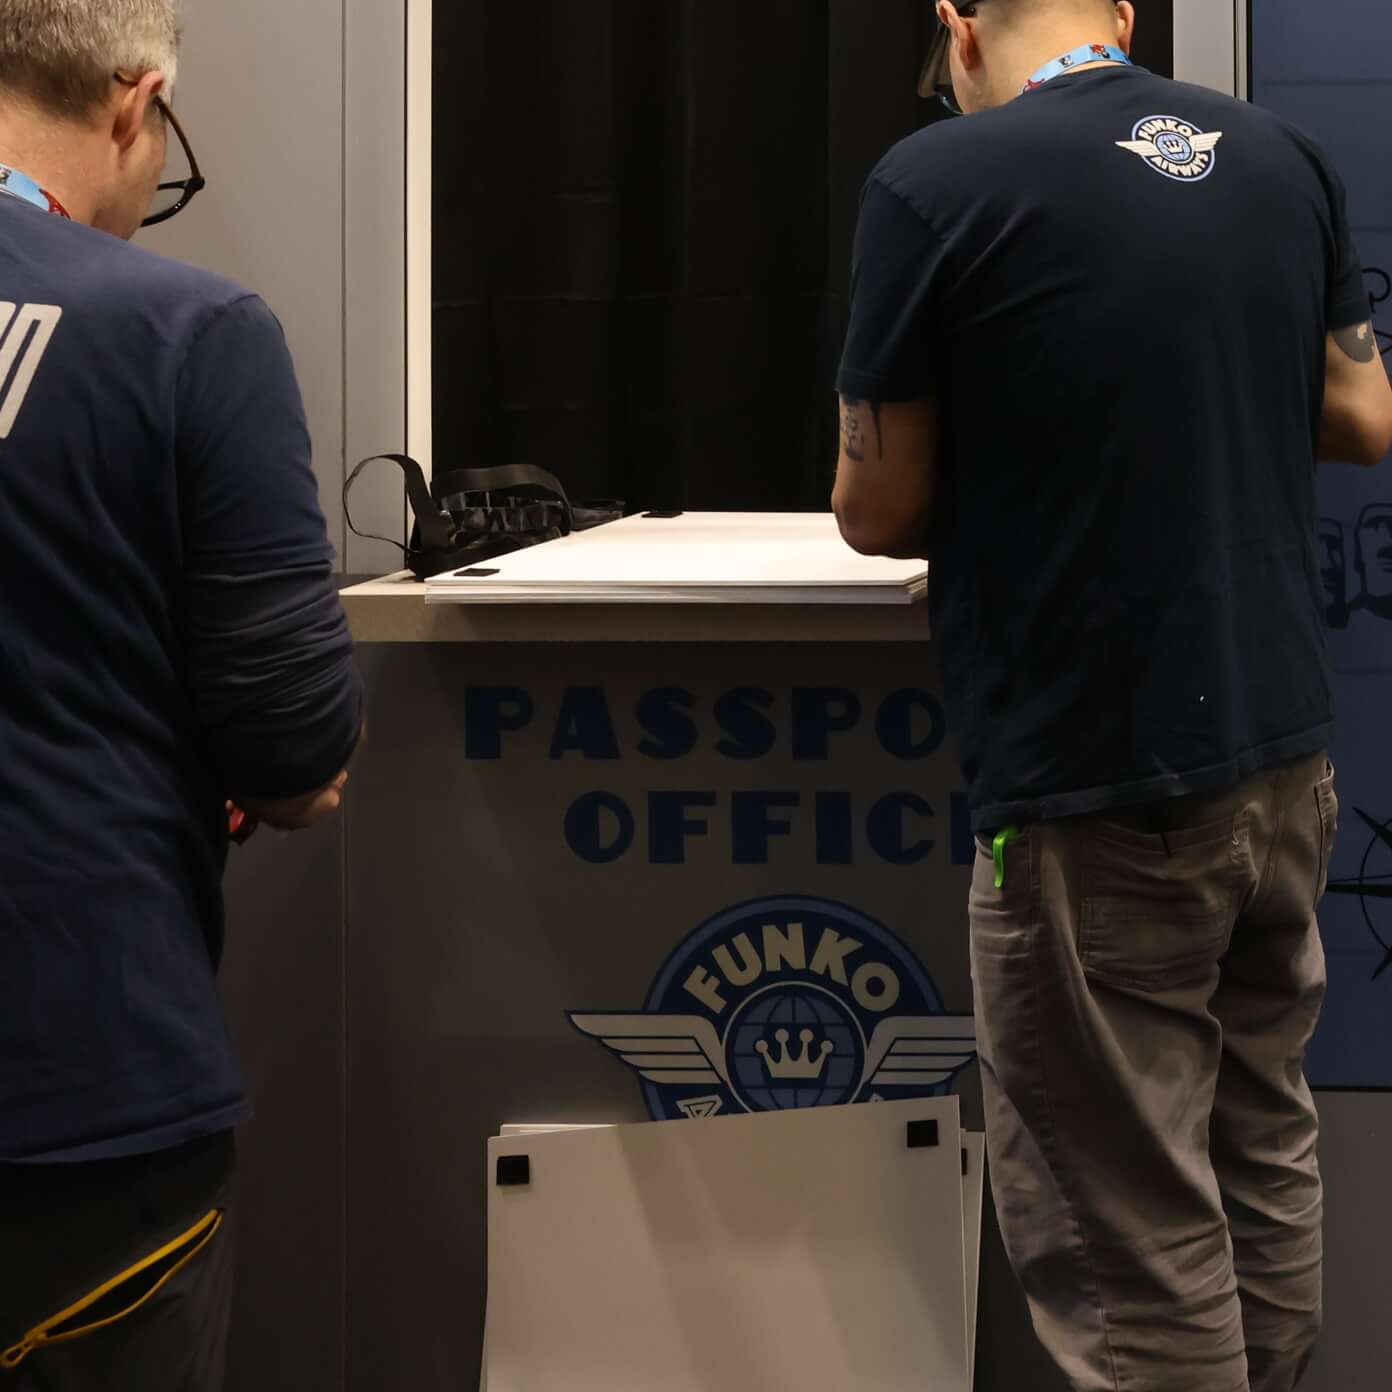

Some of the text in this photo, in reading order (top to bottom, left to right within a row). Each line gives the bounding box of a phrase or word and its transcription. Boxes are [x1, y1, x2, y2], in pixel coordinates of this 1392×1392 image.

[1137, 118, 1194, 142] FUNKO
[1149, 151, 1209, 177] AIRWAYS
[463, 685, 946, 762] PASSPO
[682, 921, 901, 1014] FUNKO
